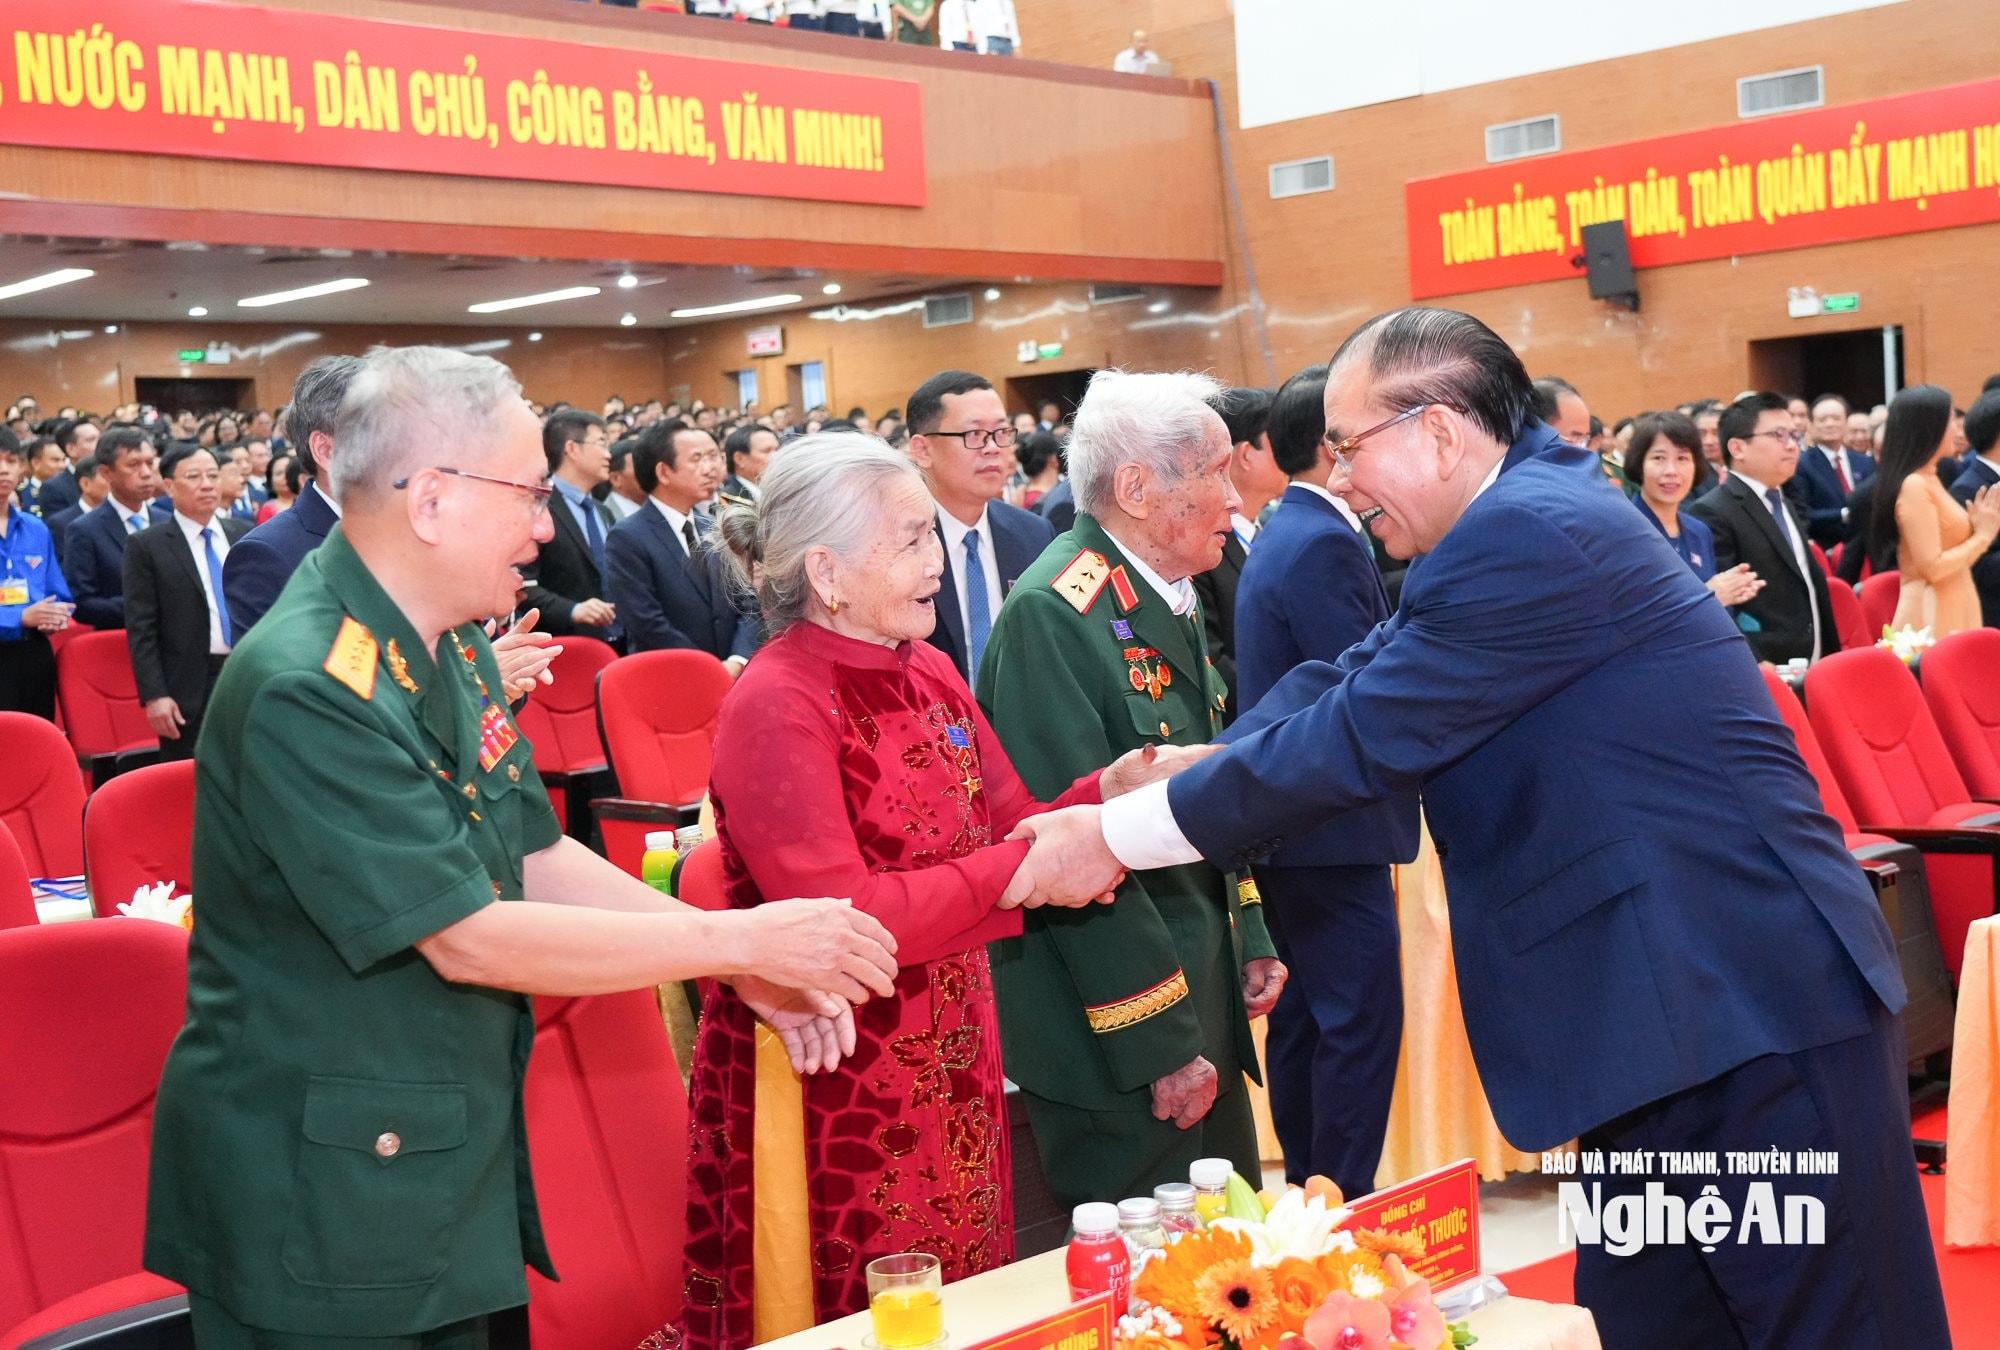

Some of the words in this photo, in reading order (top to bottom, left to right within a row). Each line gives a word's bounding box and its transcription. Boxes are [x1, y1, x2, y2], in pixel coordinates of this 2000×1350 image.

[14, 22, 147, 113] NƯỚC
[157, 44, 305, 134] MẠNH,
[312, 49, 401, 133] DÂN
[408, 54, 499, 149] CHỦ,
[506, 69, 607, 150] CÔNG
[612, 69, 717, 166] BẰNG,
[720, 91, 788, 164] VĂN
[792, 108, 885, 172] MINH!
[1439, 197, 1496, 266] TOÀN
[1497, 182, 1565, 257] ĐẢNG,
[1628, 166, 1686, 239] DÂN,
[1687, 153, 1753, 229] TOÀN
[1756, 143, 1827, 225] QUÂN
[1829, 120, 1882, 210] ĐẨY
[1886, 128, 1968, 211] MẠNH
[1428, 1206, 1468, 1246] THƯỚC
